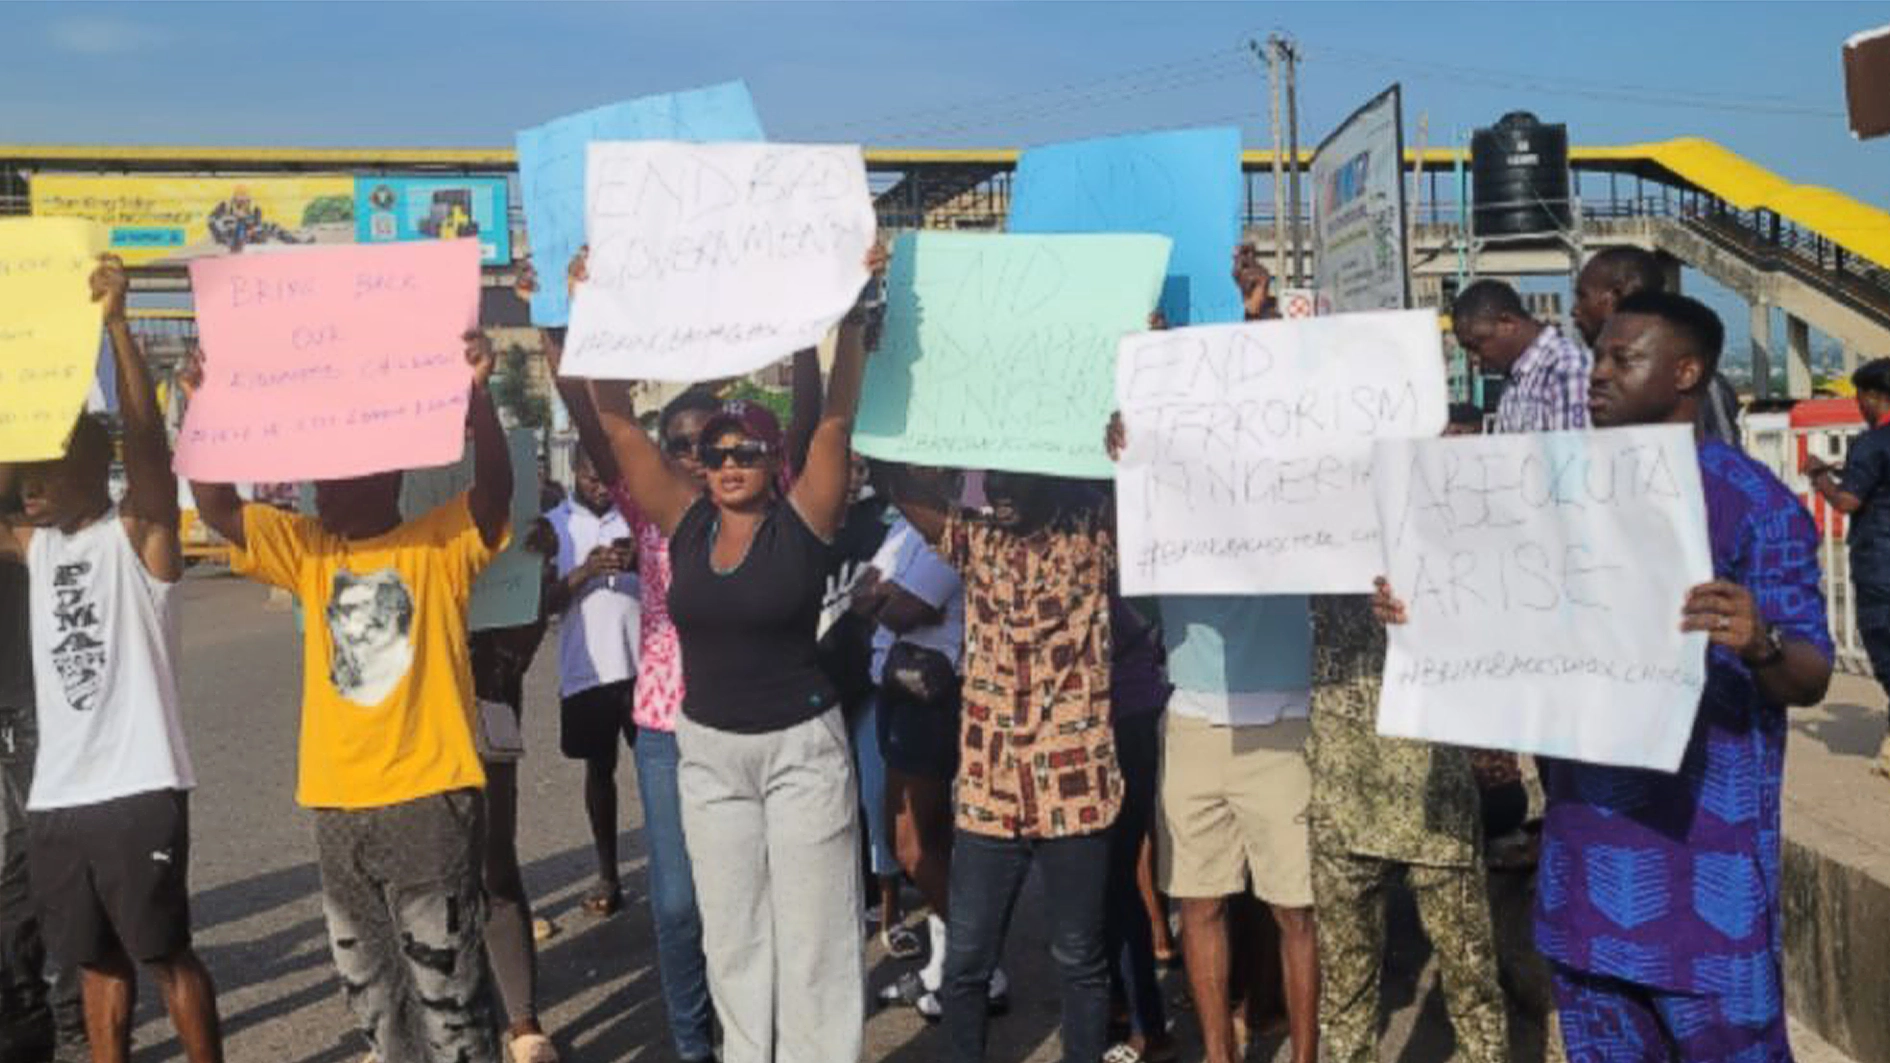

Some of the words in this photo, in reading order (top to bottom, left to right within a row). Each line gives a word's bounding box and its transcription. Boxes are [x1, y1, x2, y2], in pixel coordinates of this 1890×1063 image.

[593, 153, 739, 223] END
[747, 148, 853, 206] BAD
[230, 274, 316, 308] BRING
[291, 323, 345, 351] OUR
[1128, 331, 1275, 398] END
[1132, 380, 1419, 455] TERRORISM
[1397, 445, 1682, 547] ABEOKUTA
[1409, 541, 1623, 616] ARISE
